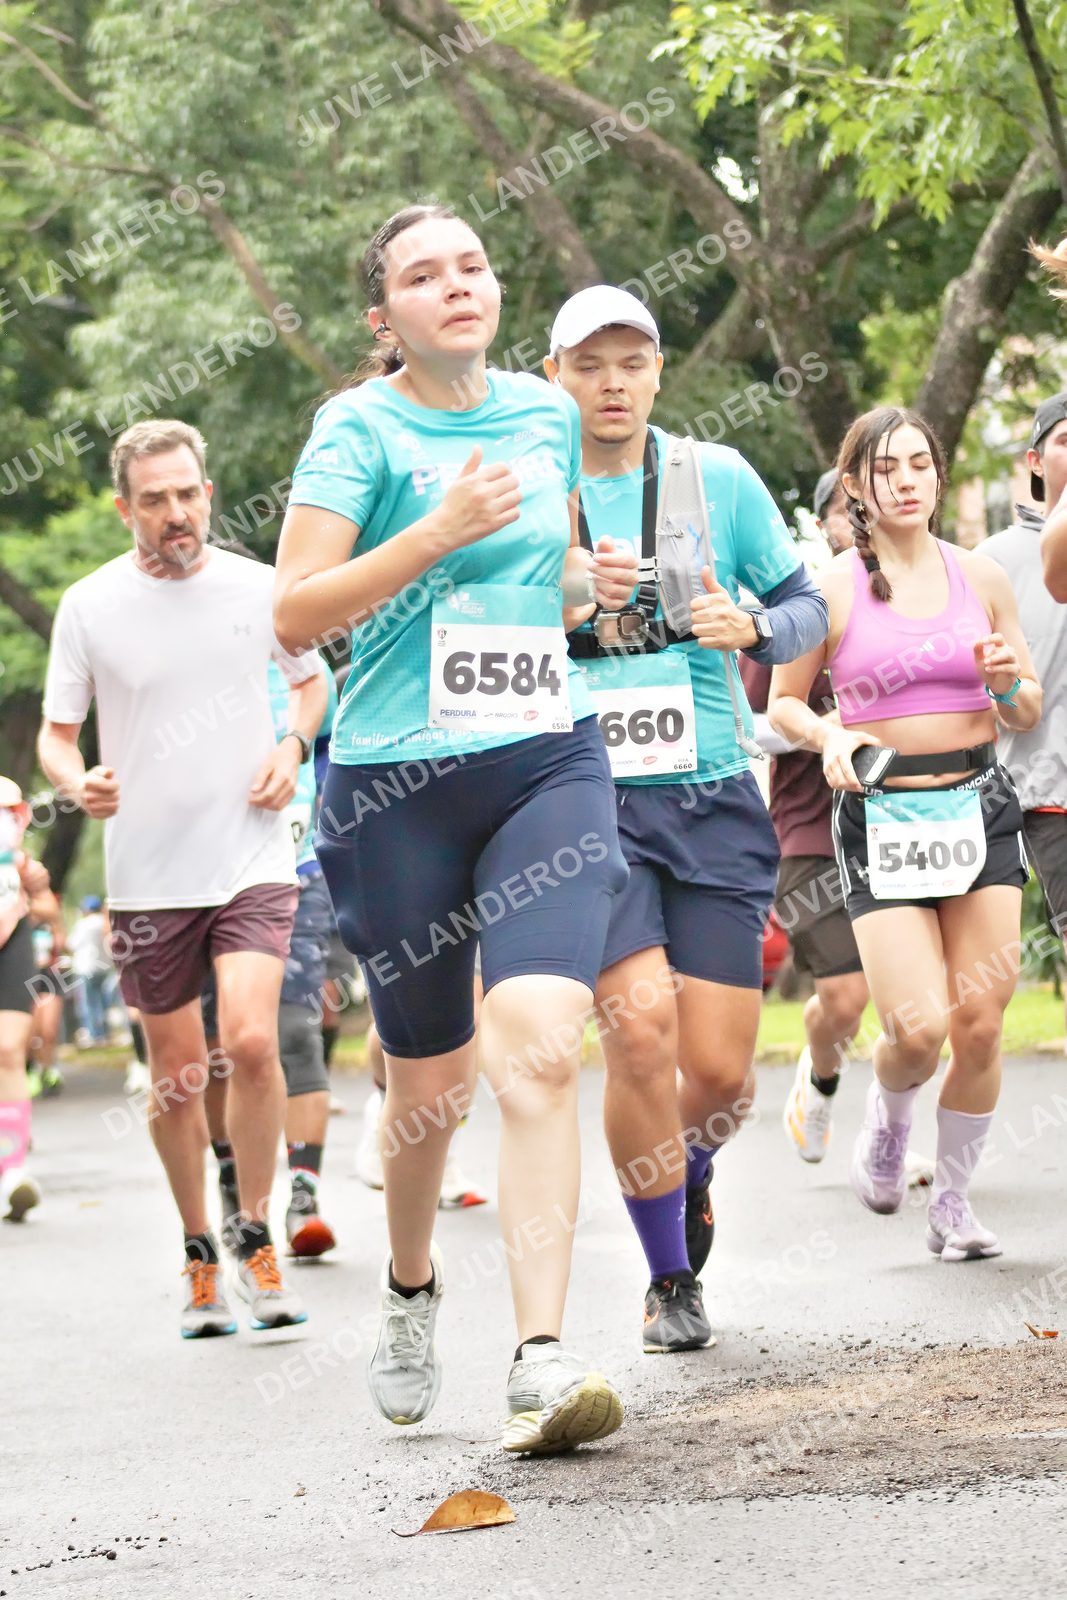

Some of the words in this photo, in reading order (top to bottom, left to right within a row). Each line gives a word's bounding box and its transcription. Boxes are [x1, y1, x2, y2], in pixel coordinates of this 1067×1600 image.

[443, 651, 561, 696] 6584
[440, 709, 477, 718] PERDURA
[552, 722, 570, 730] 6584
[878, 838, 978, 873] 5400
